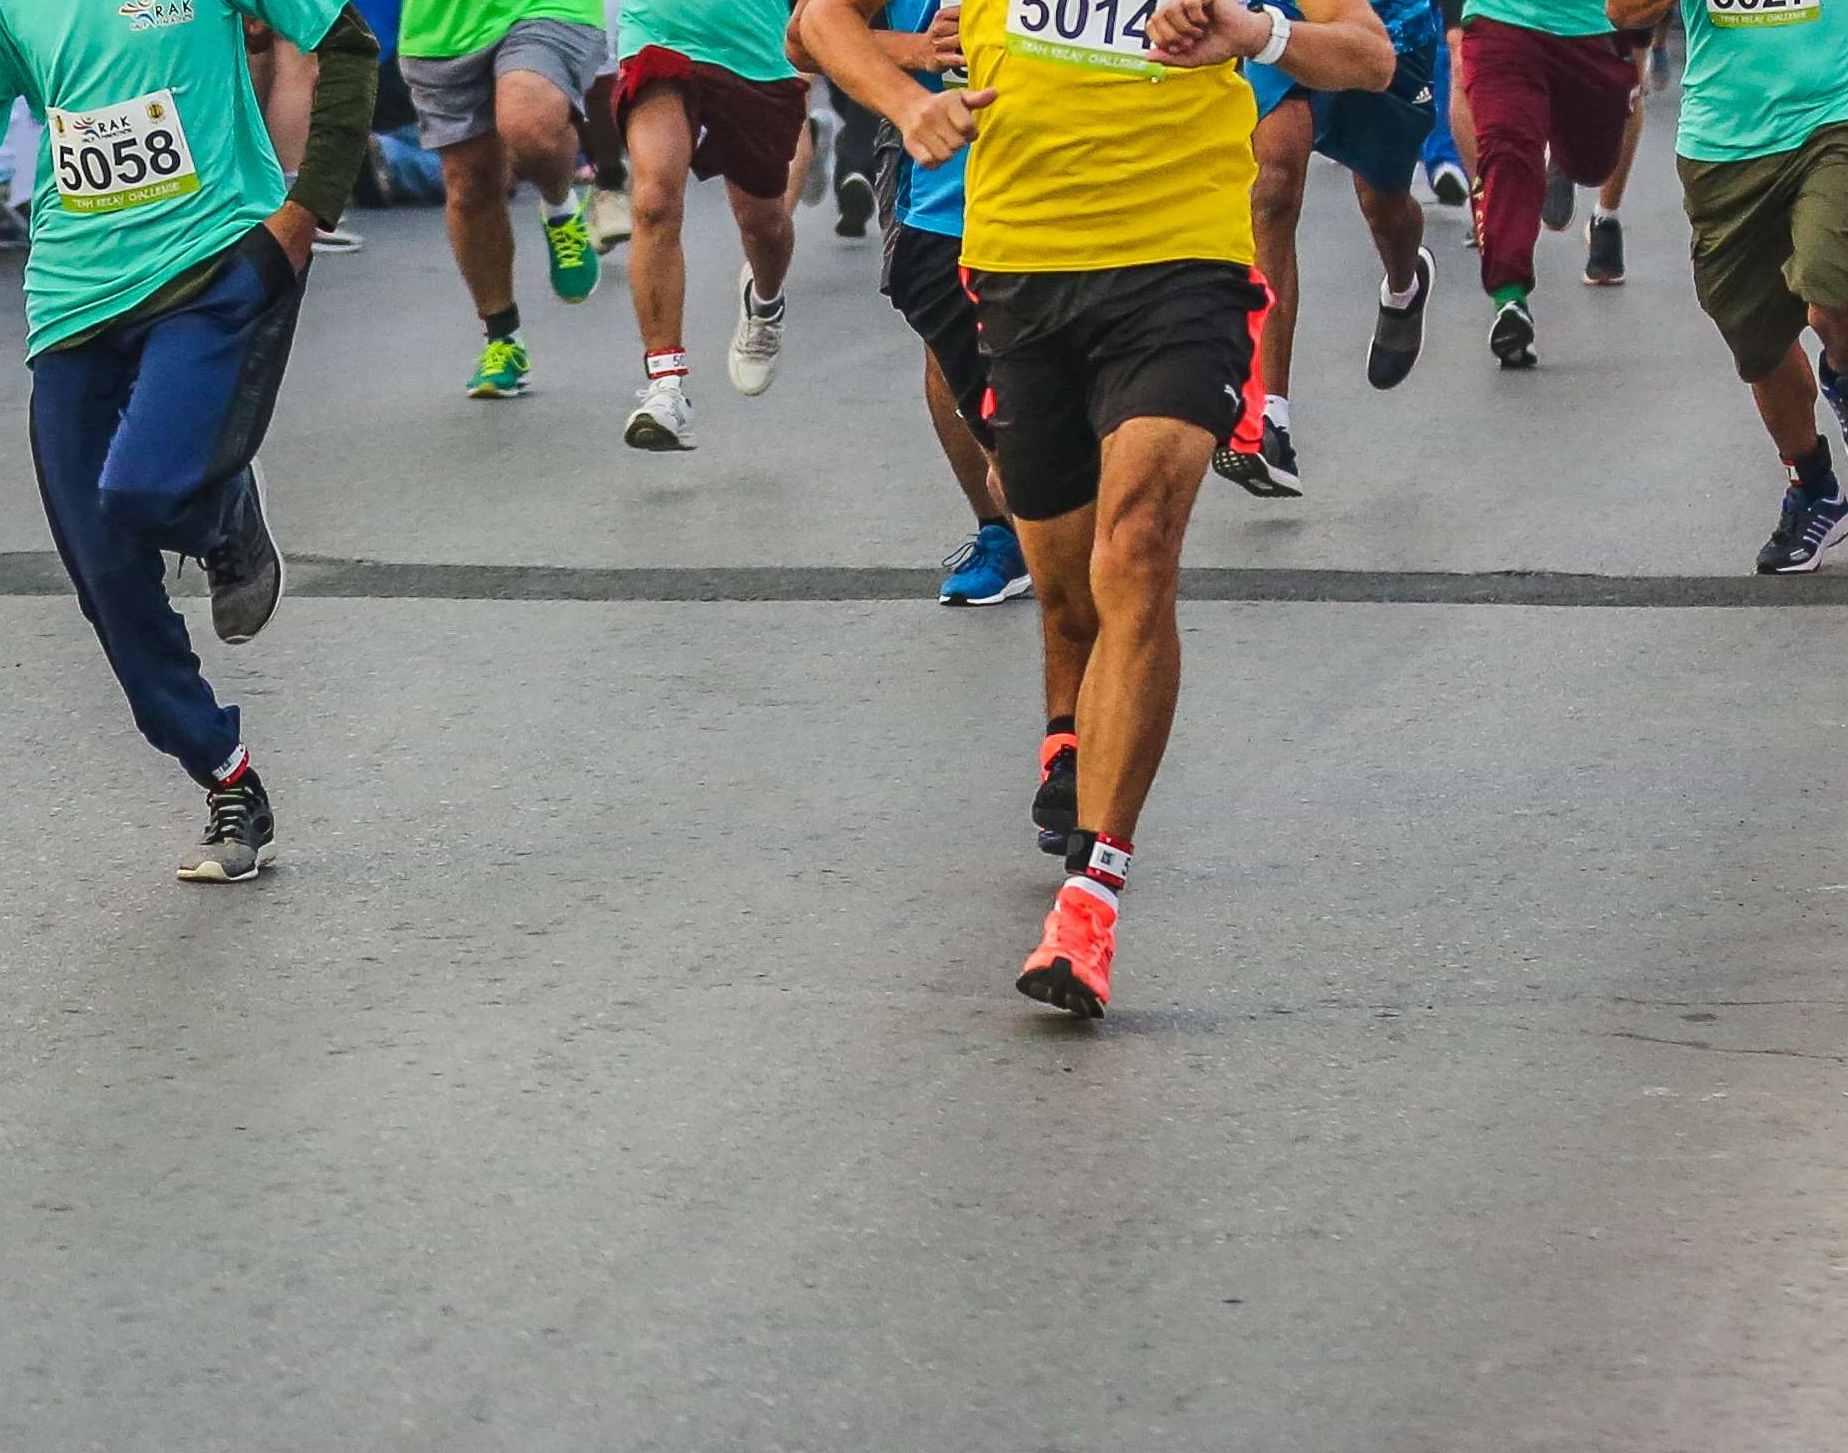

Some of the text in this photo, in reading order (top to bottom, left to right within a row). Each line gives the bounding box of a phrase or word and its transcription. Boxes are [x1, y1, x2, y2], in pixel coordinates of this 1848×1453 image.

[155, 0, 193, 18] RAK
[98, 116, 131, 134] RAK
[59, 129, 182, 191] 5058
[72, 196, 95, 209] TEAM
[97, 193, 125, 207] RELAY
